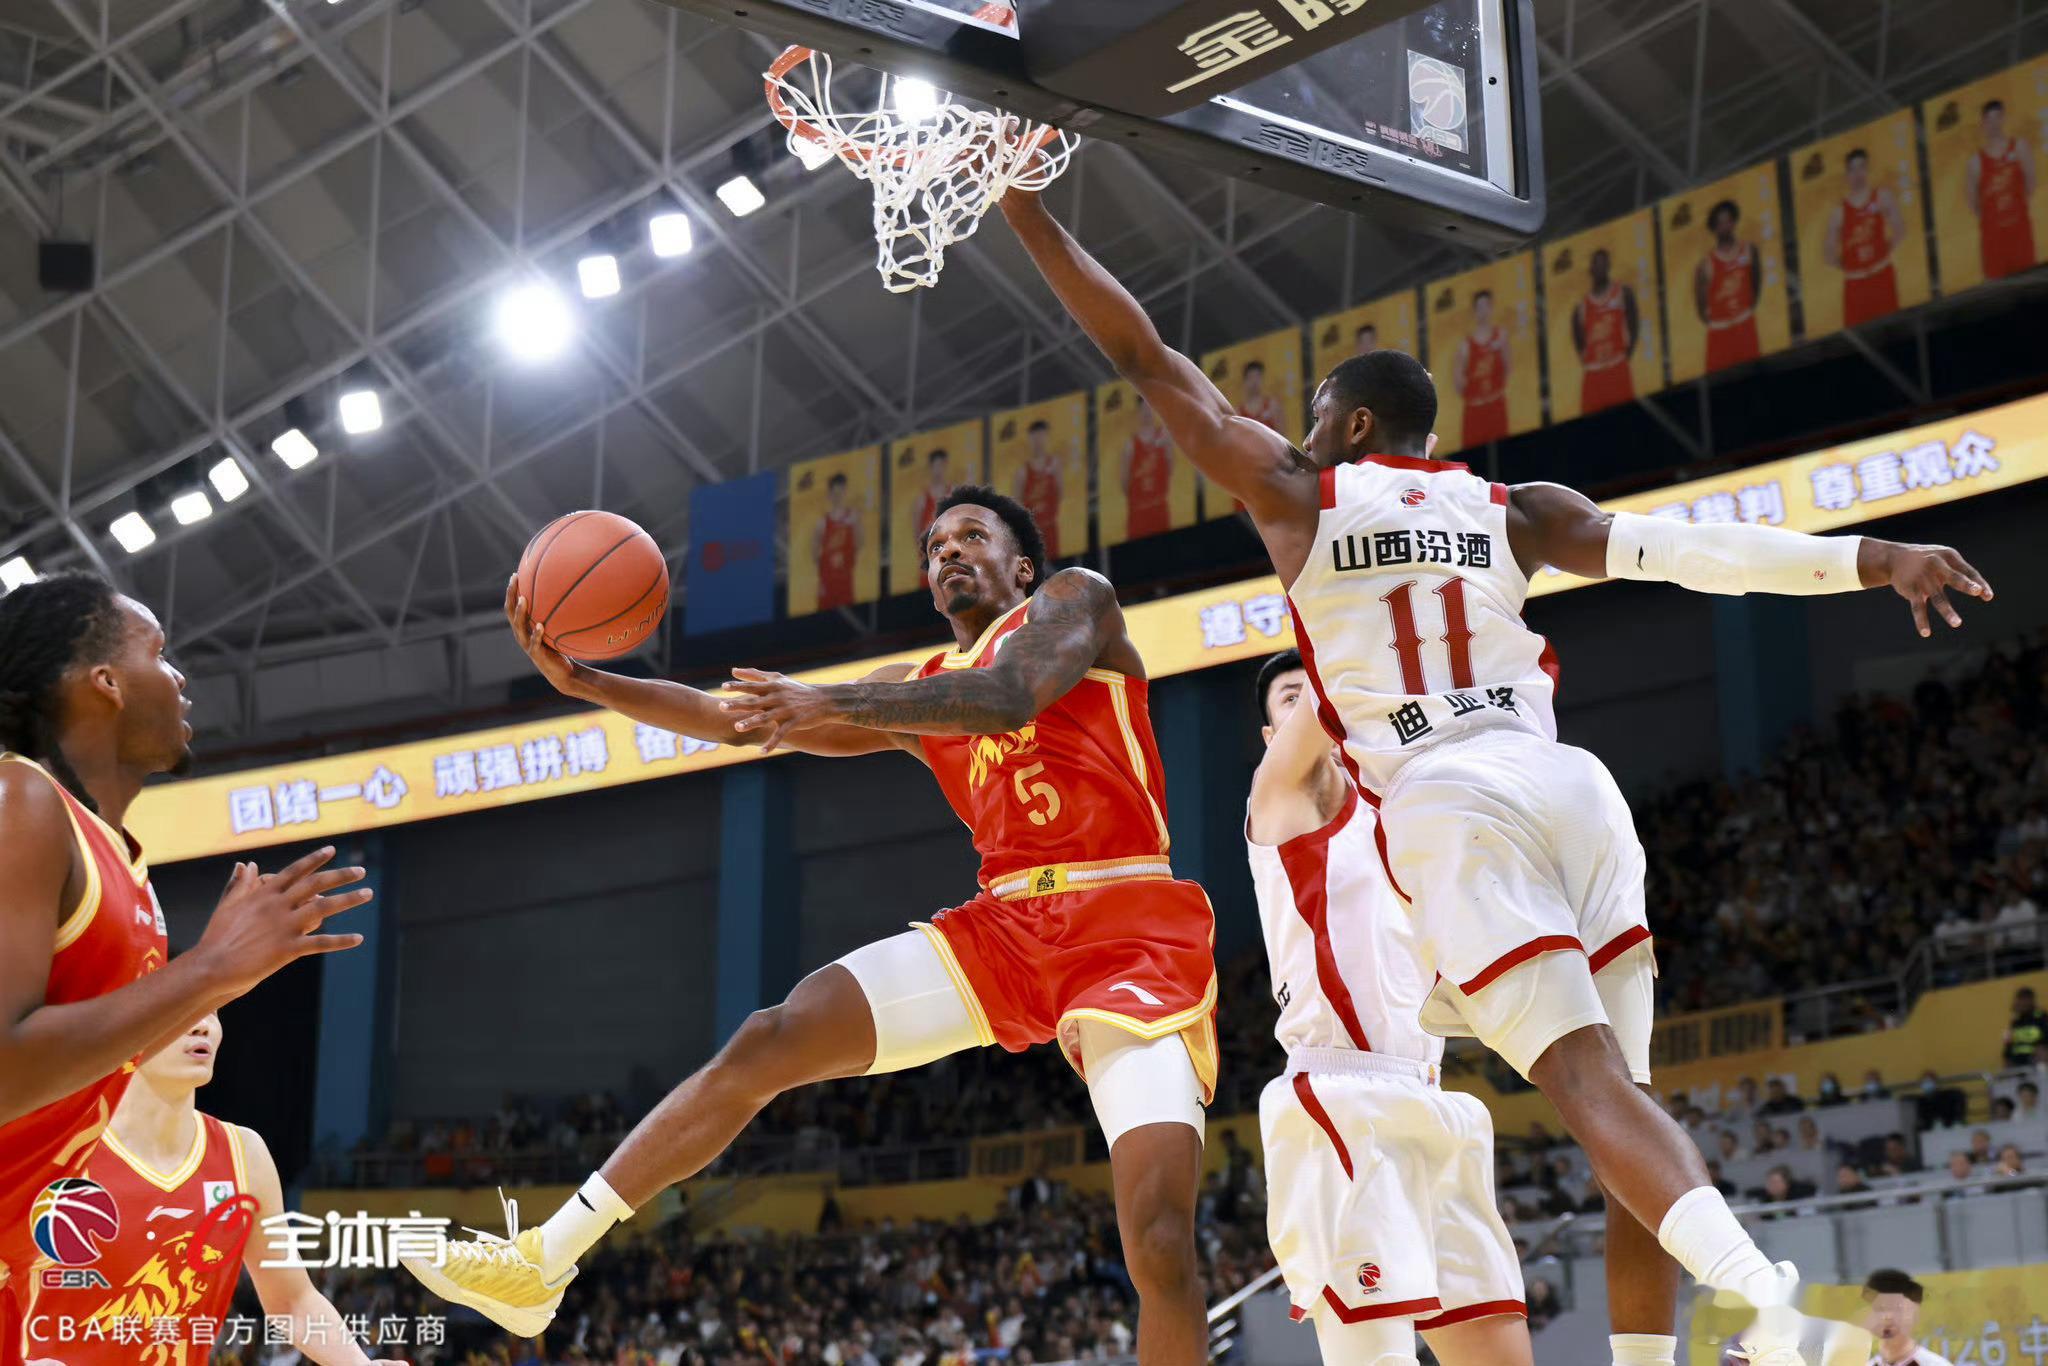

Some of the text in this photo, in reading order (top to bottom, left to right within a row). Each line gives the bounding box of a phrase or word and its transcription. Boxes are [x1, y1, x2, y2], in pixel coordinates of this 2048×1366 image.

[1333, 529, 1491, 571] 山西汾酒
[229, 764, 408, 834] 团结一心
[434, 727, 608, 797] 顽强拼搏
[1810, 431, 1999, 511] 尊重观众
[1379, 576, 1477, 696] 11
[1013, 760, 1061, 826] 5
